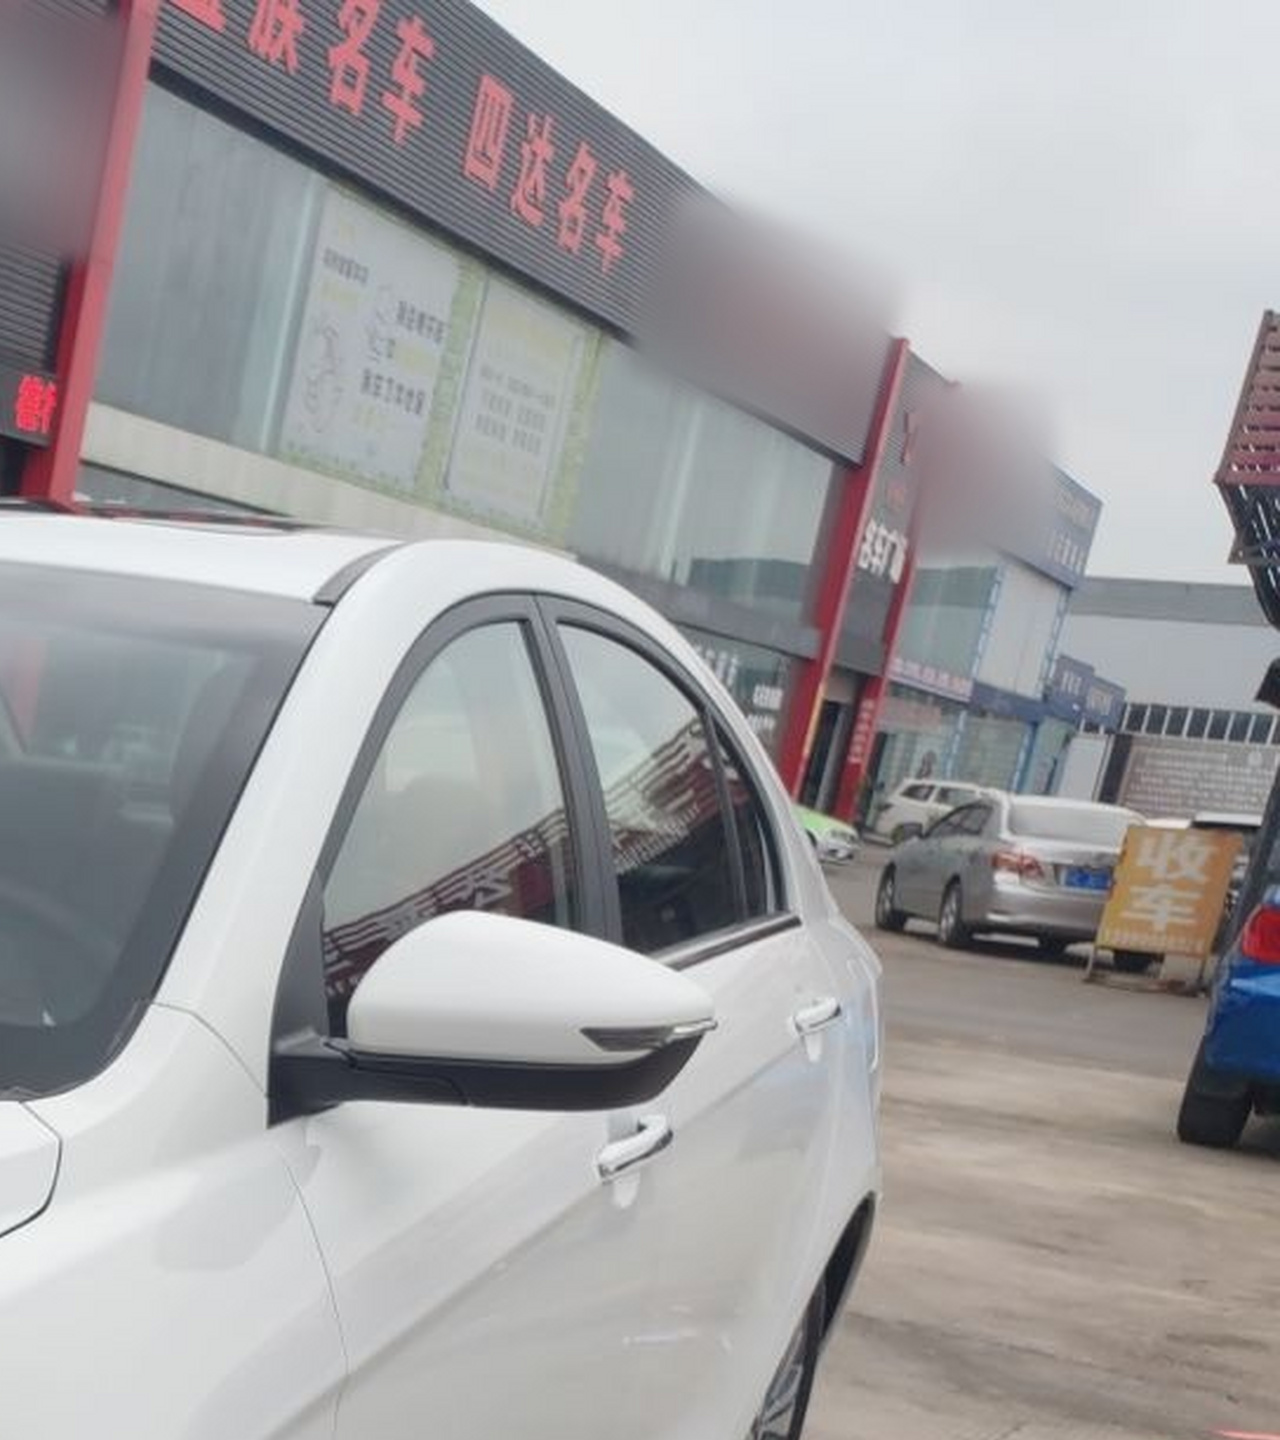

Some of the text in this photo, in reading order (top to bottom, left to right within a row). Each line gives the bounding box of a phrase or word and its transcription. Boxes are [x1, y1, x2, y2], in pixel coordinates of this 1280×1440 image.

[166, 0, 635, 278] 族名车 四达名车
